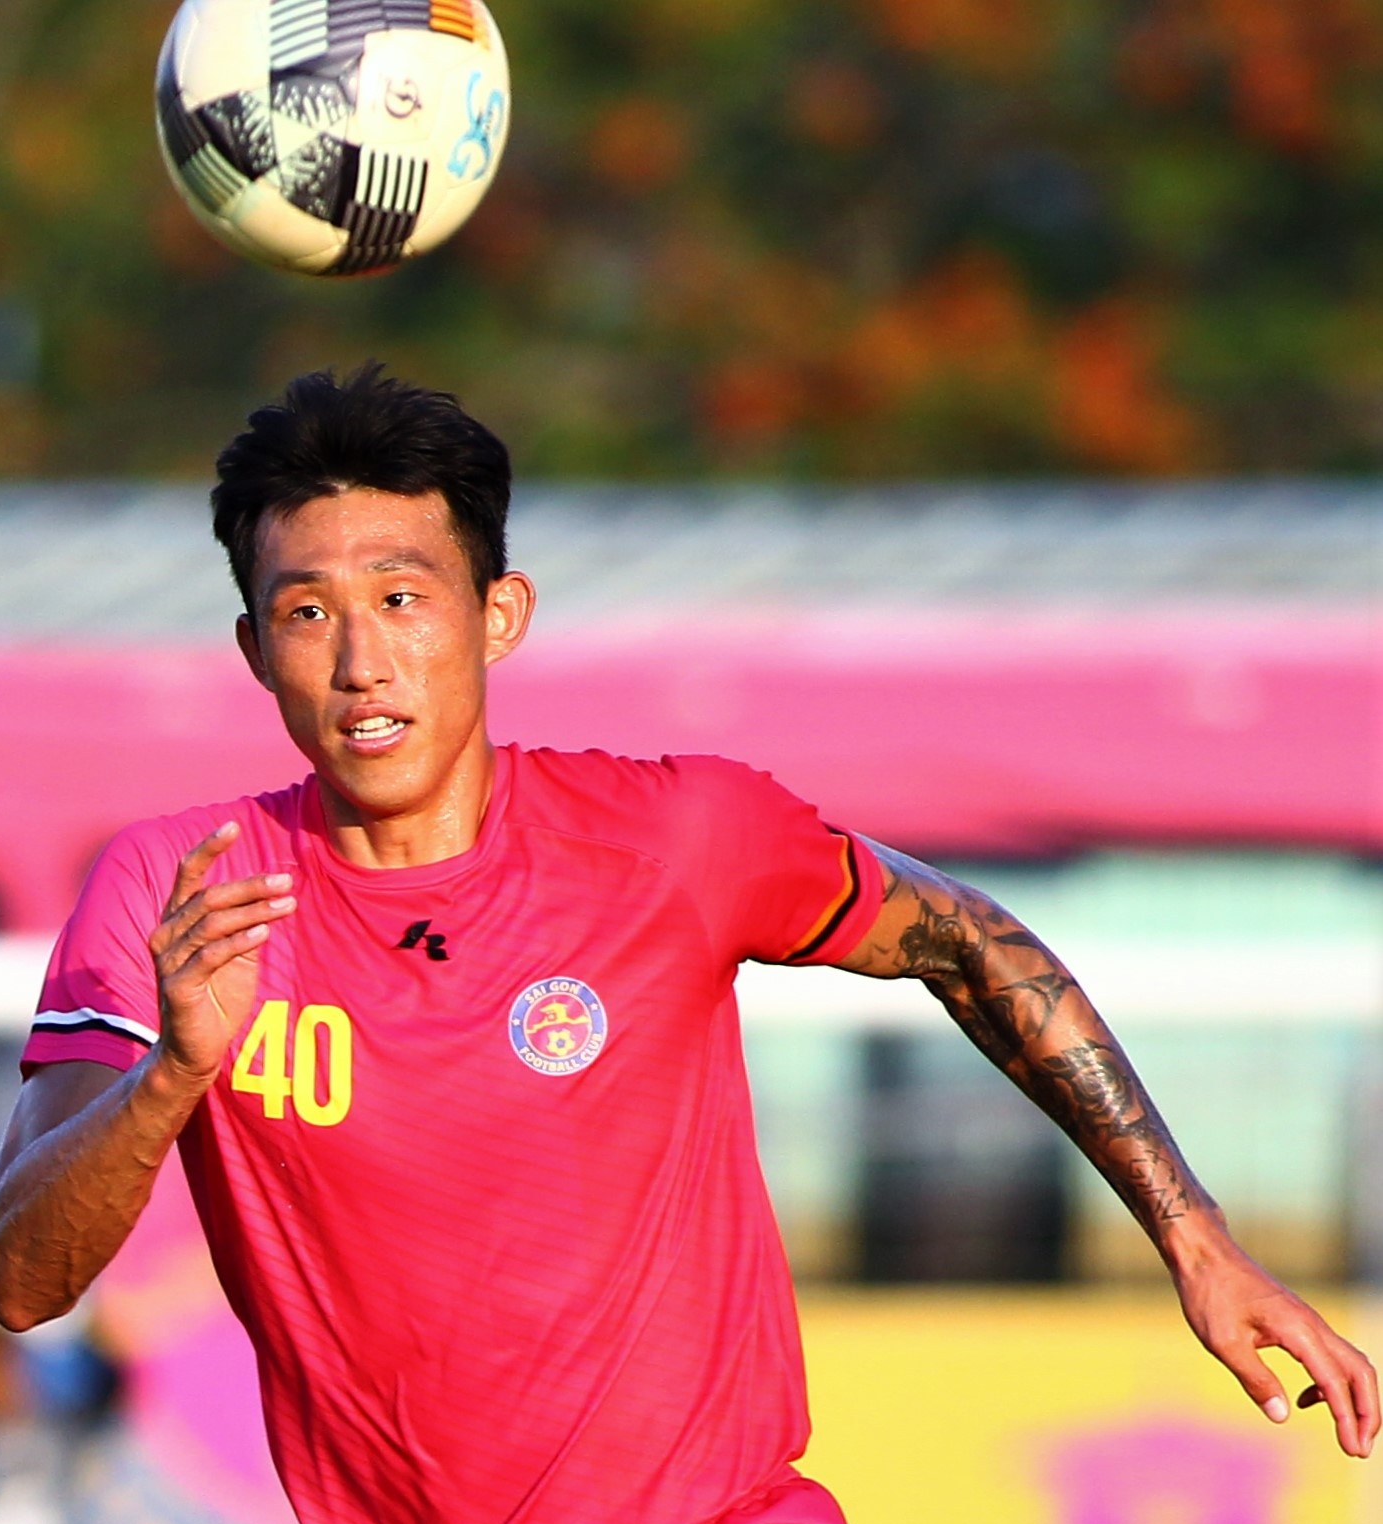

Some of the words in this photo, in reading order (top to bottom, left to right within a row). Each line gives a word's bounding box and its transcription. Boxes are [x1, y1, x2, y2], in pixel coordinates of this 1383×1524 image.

[524, 984, 547, 1004] SAI
[549, 981, 581, 995] GON
[231, 1000, 353, 1127] 40
[518, 1045, 581, 1073] FOOTBALL
[579, 1033, 603, 1063] CLUB
